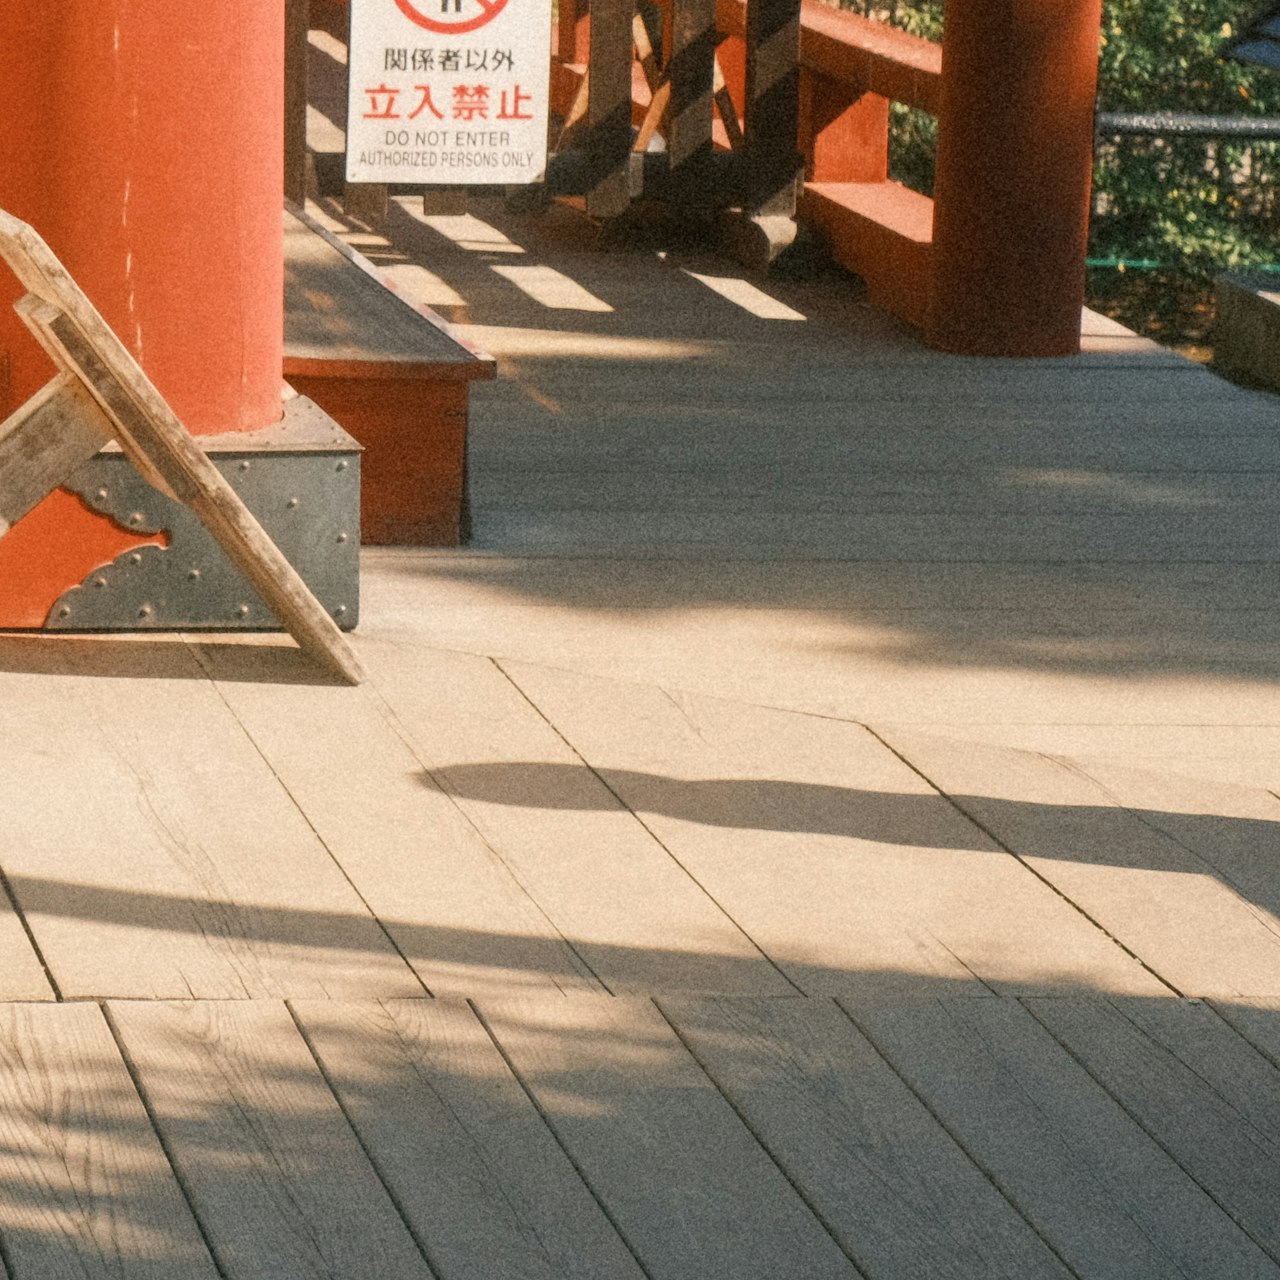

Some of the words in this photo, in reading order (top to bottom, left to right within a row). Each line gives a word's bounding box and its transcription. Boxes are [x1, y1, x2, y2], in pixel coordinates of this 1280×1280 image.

[383, 47, 516, 73] 関係者以外
[362, 84, 534, 121] 立入禁止
[385, 131, 409, 146] DO
[415, 131, 449, 146] NOT
[456, 131, 510, 146] ENTER
[360, 150, 438, 167] AUTHORIZED
[441, 151, 498, 167] PERSONS
[502, 151, 534, 168] ONLY
